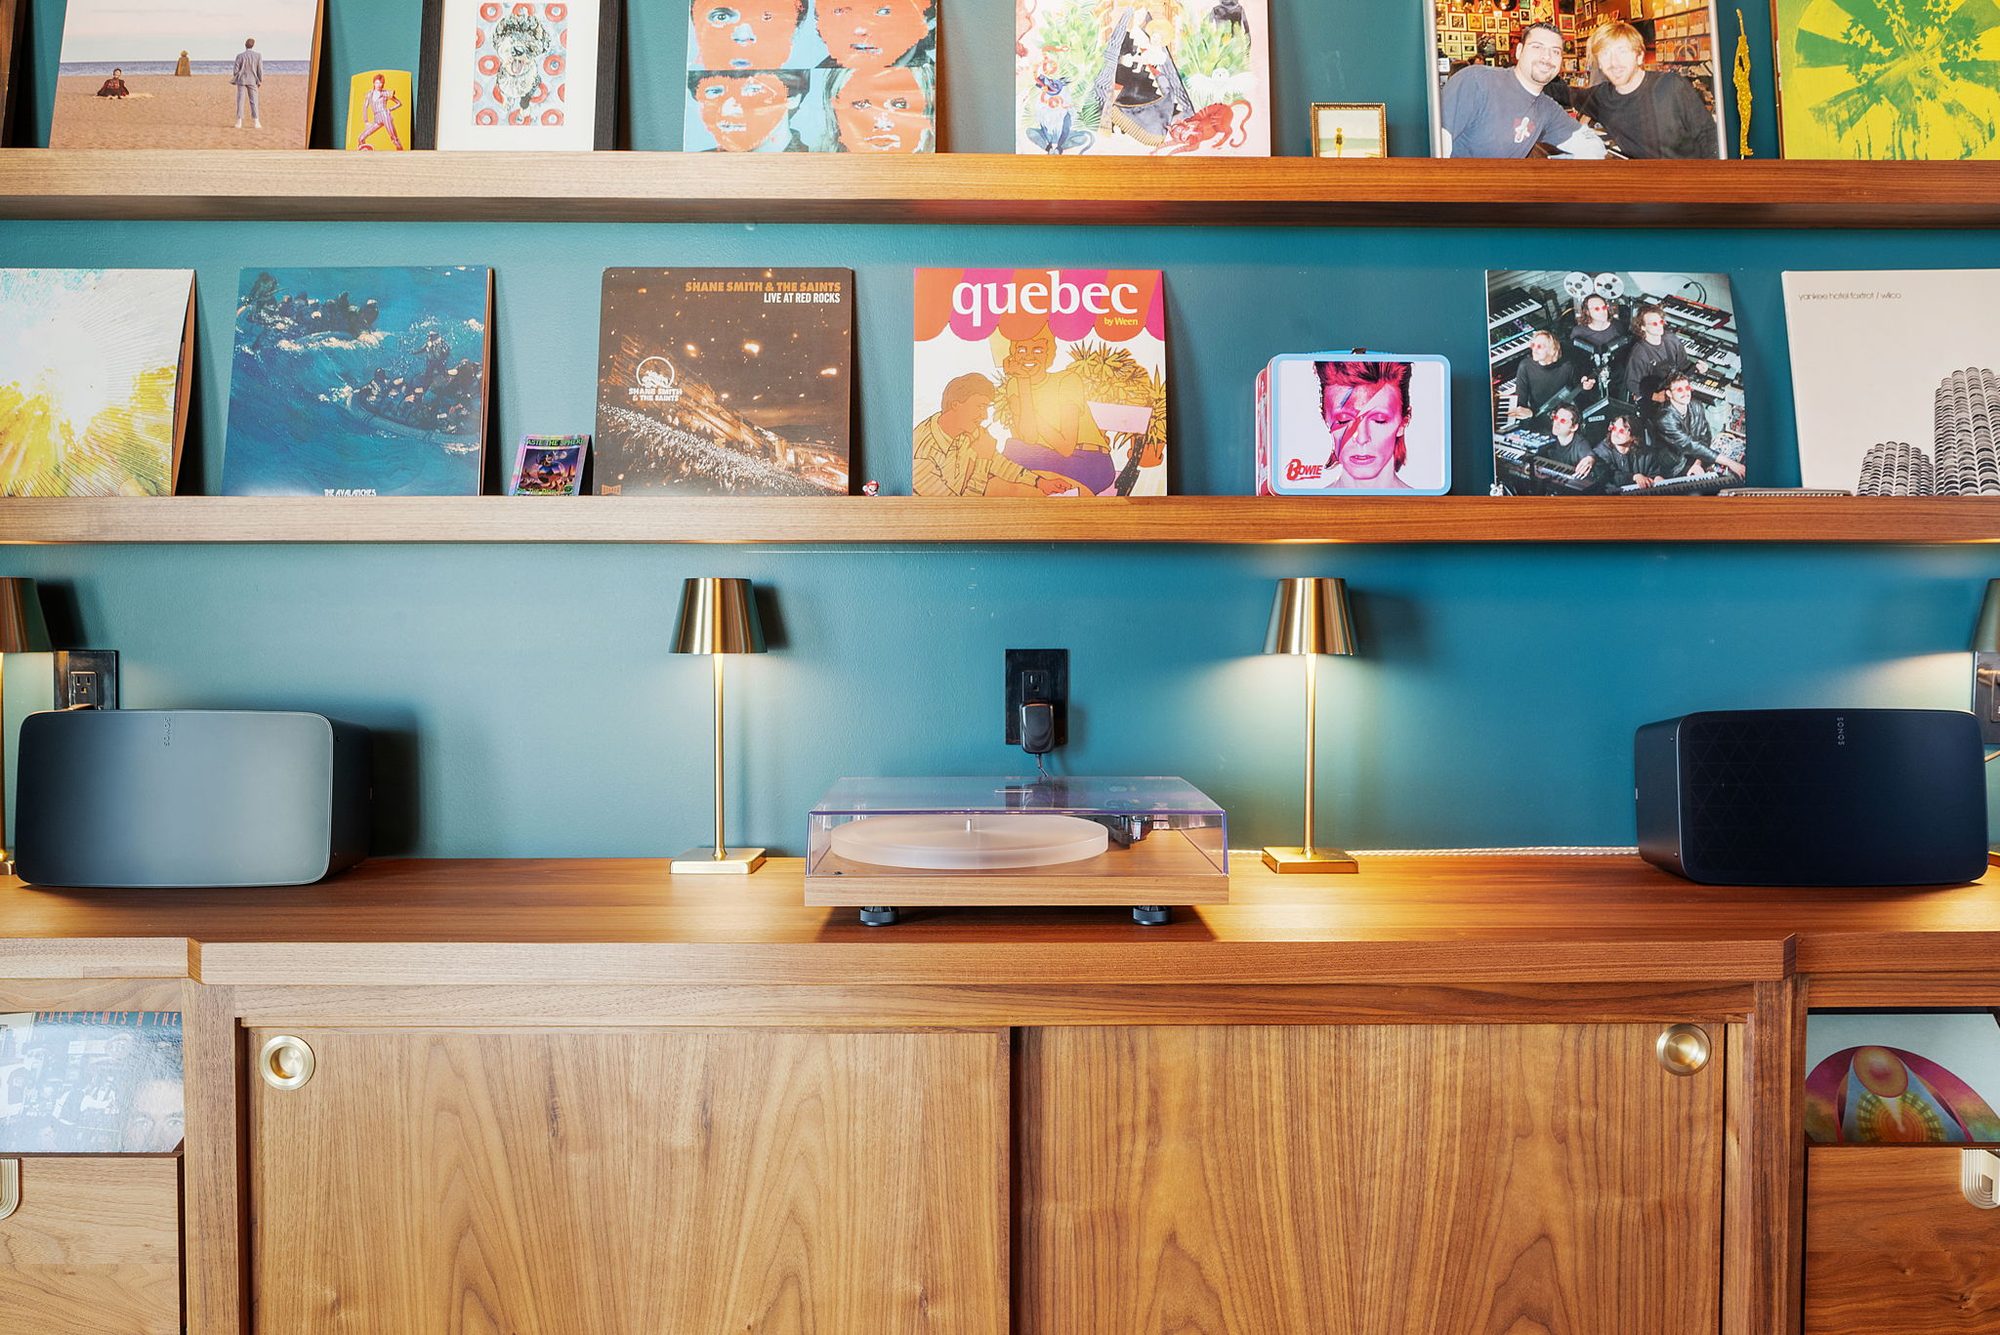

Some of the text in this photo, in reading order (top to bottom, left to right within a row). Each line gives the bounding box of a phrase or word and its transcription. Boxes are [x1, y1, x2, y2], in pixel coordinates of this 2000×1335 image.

[685, 282, 841, 292] SHANE SMITH & THE SAINTS
[763, 293, 841, 304] LIVE AT RED ROCKS
[952, 270, 1139, 327] quebec
[1798, 292, 1828, 301] yankee
[1104, 317, 1139, 326] by Ween
[163, 716, 171, 747] SONOS
[1836, 716, 1845, 746] SONOS
[153, 1012, 179, 1027] THE
